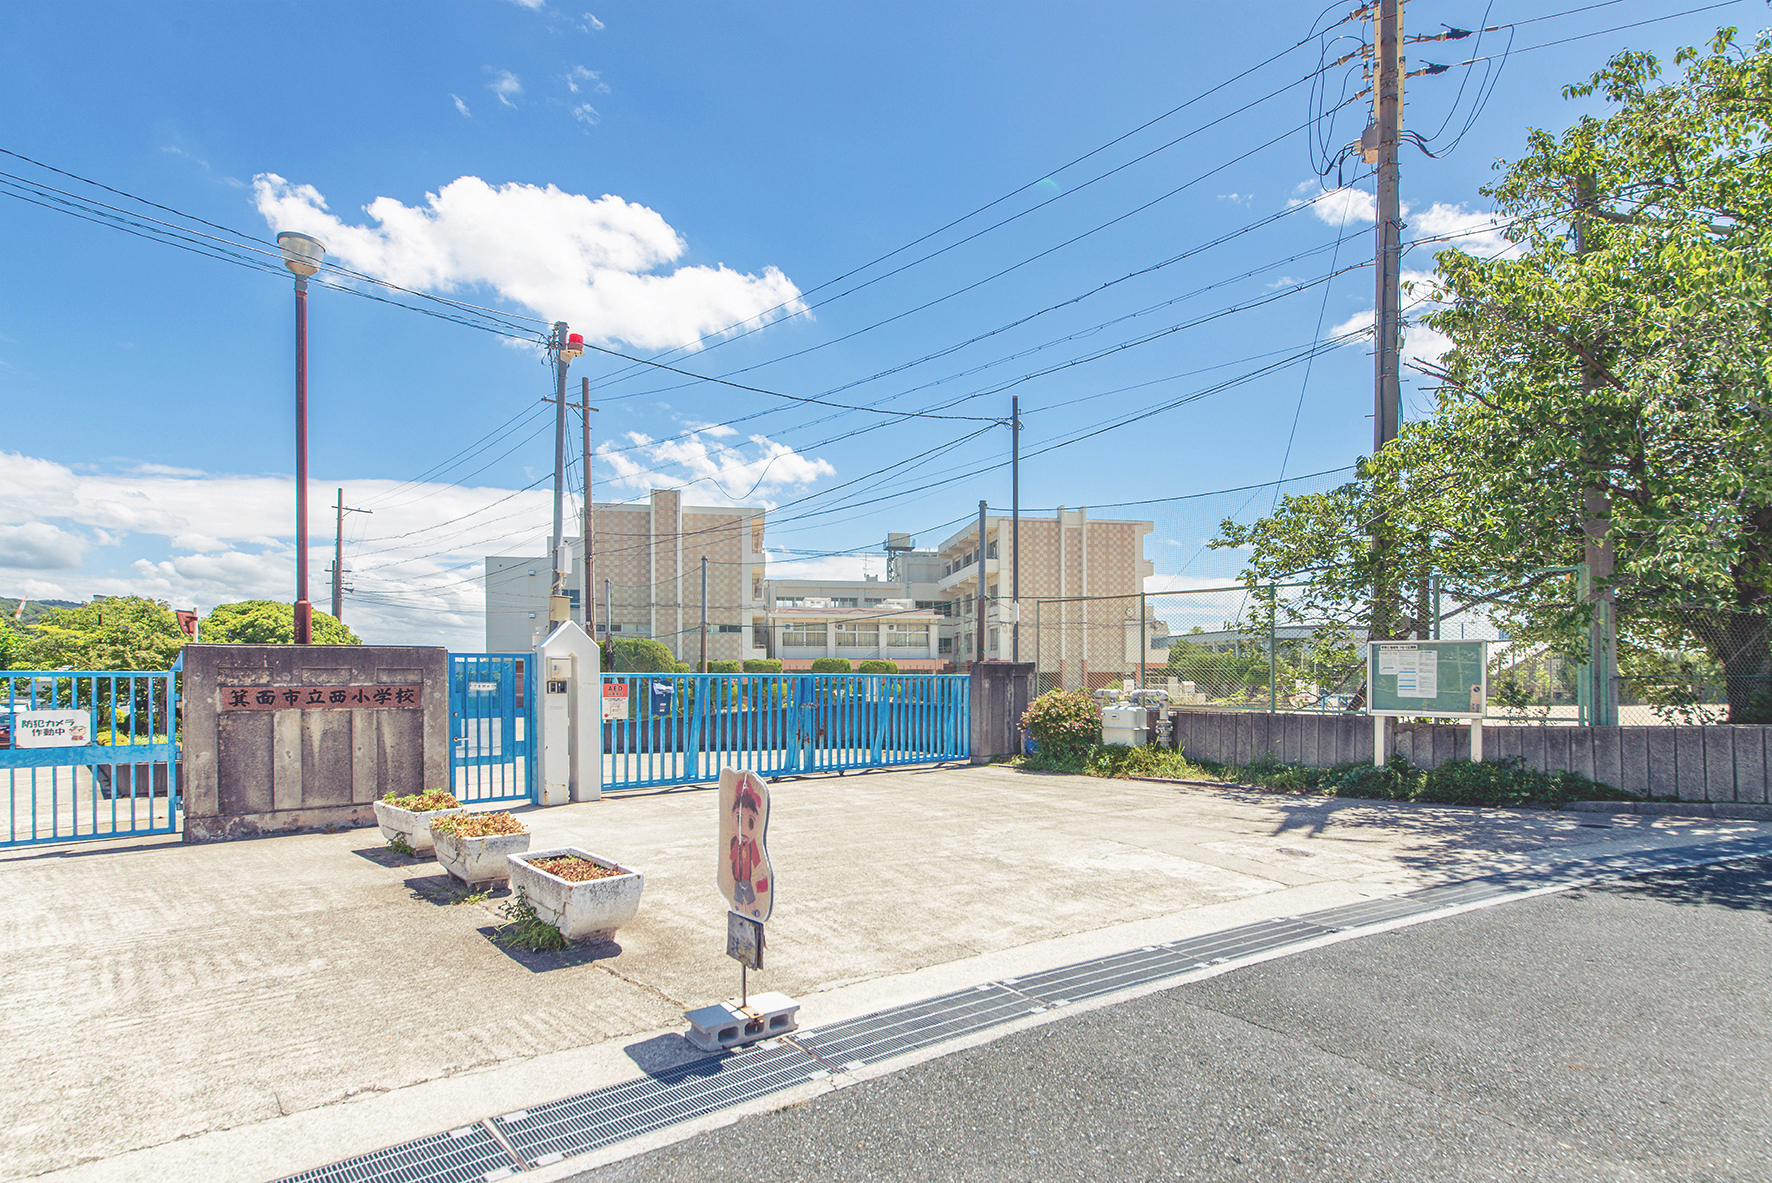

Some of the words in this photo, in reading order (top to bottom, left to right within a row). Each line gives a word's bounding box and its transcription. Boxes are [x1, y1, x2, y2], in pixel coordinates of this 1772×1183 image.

[228, 687, 416, 708] 箕面市立西小学校
[21, 718, 75, 729] 防犯カメラ
[31, 728, 66, 737] 作動中
